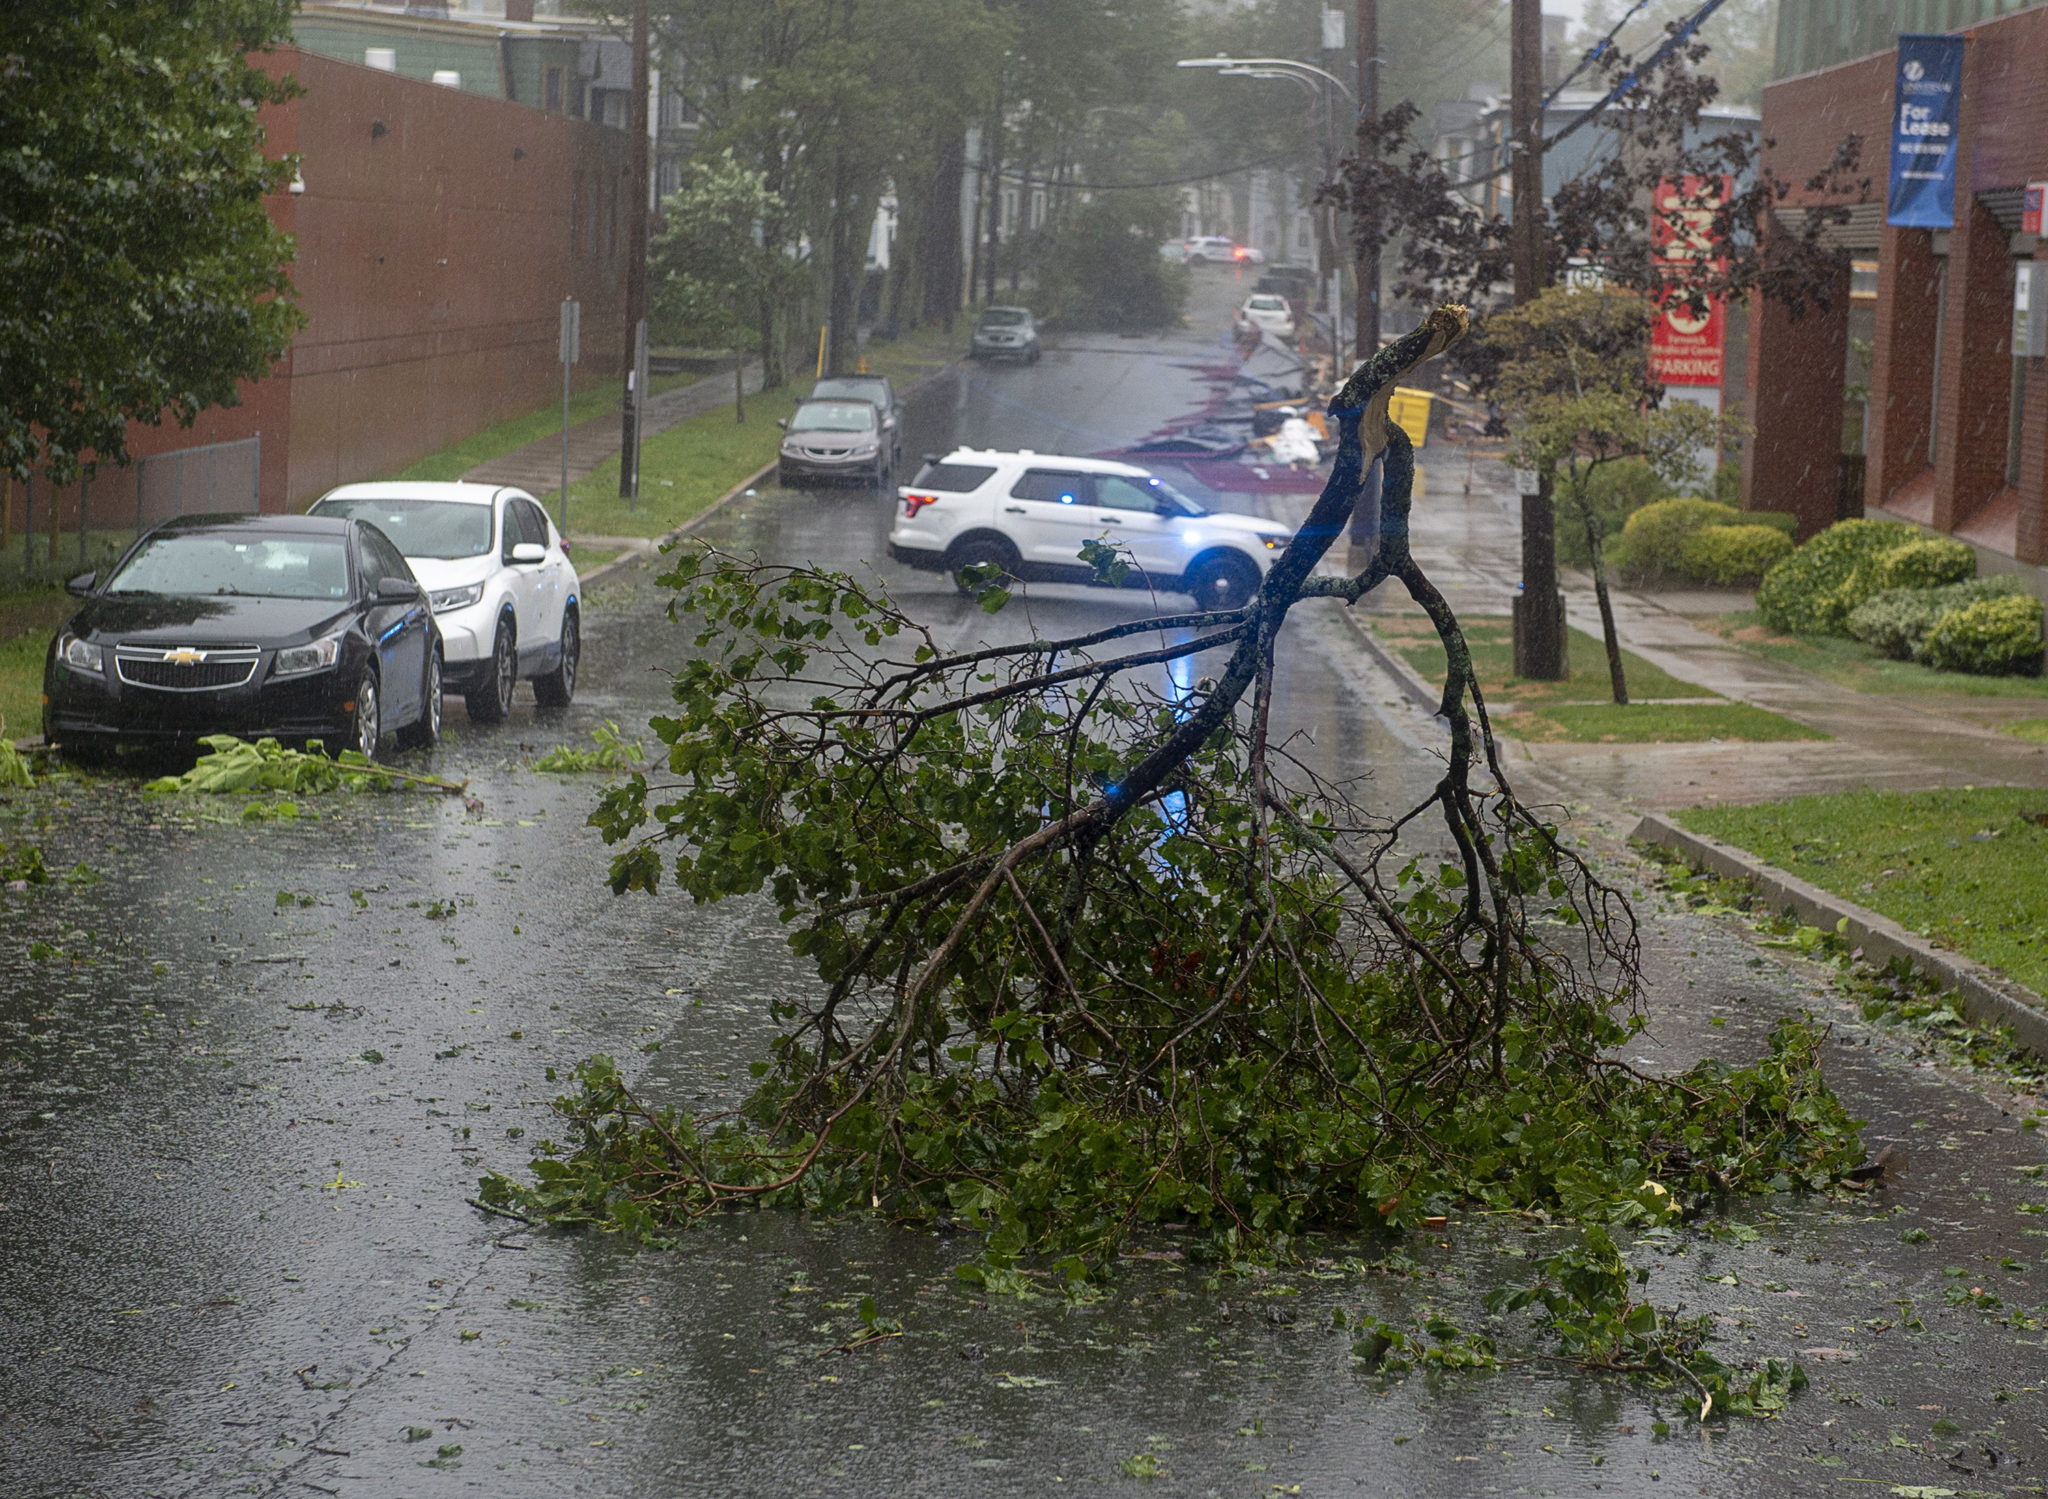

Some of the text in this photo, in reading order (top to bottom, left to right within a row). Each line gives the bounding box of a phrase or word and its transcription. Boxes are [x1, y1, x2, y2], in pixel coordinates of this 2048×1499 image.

[1901, 103, 1931, 120] For
[1900, 121, 1950, 136] Lease
[1653, 358, 1721, 376] PARKING
